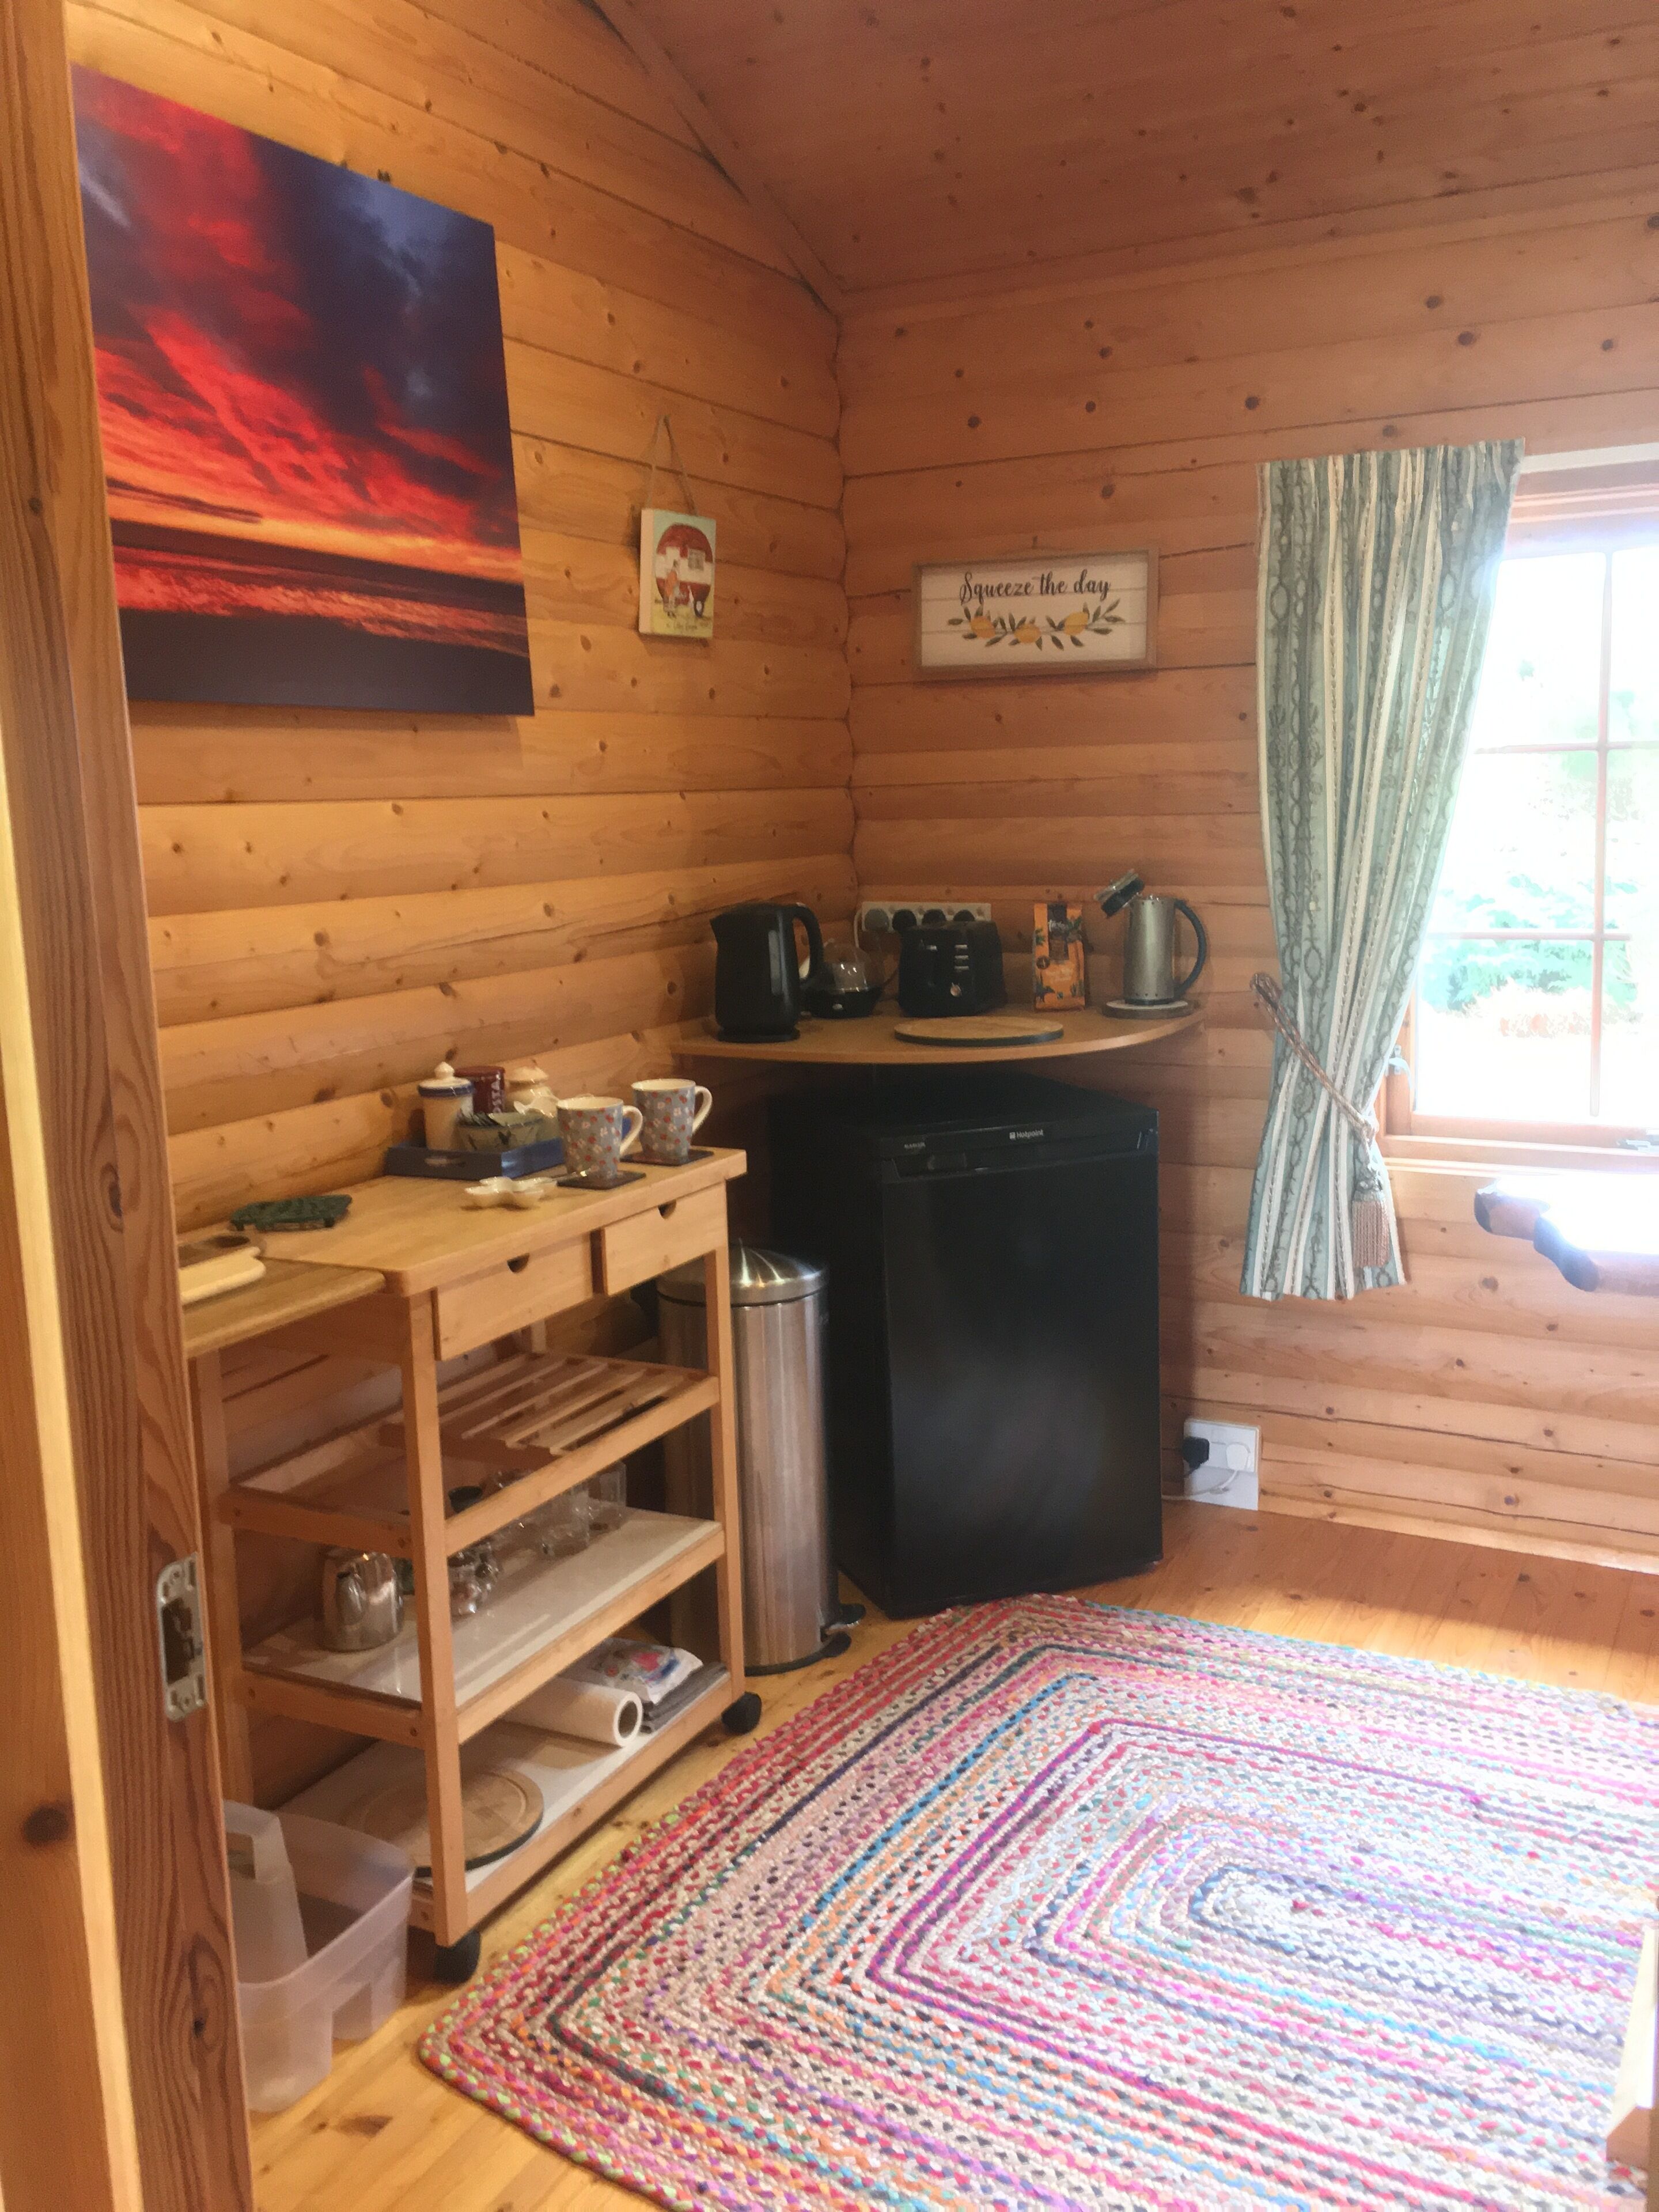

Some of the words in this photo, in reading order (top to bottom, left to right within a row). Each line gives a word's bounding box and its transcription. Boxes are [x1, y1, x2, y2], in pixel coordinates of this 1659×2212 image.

[960, 571, 1035, 607] Squeeze
[1035, 571, 1067, 595] the
[1074, 569, 1110, 601] day
[490, 1081, 502, 1113] OSTA
[1017, 1129, 1044, 1139] Hotpoint
